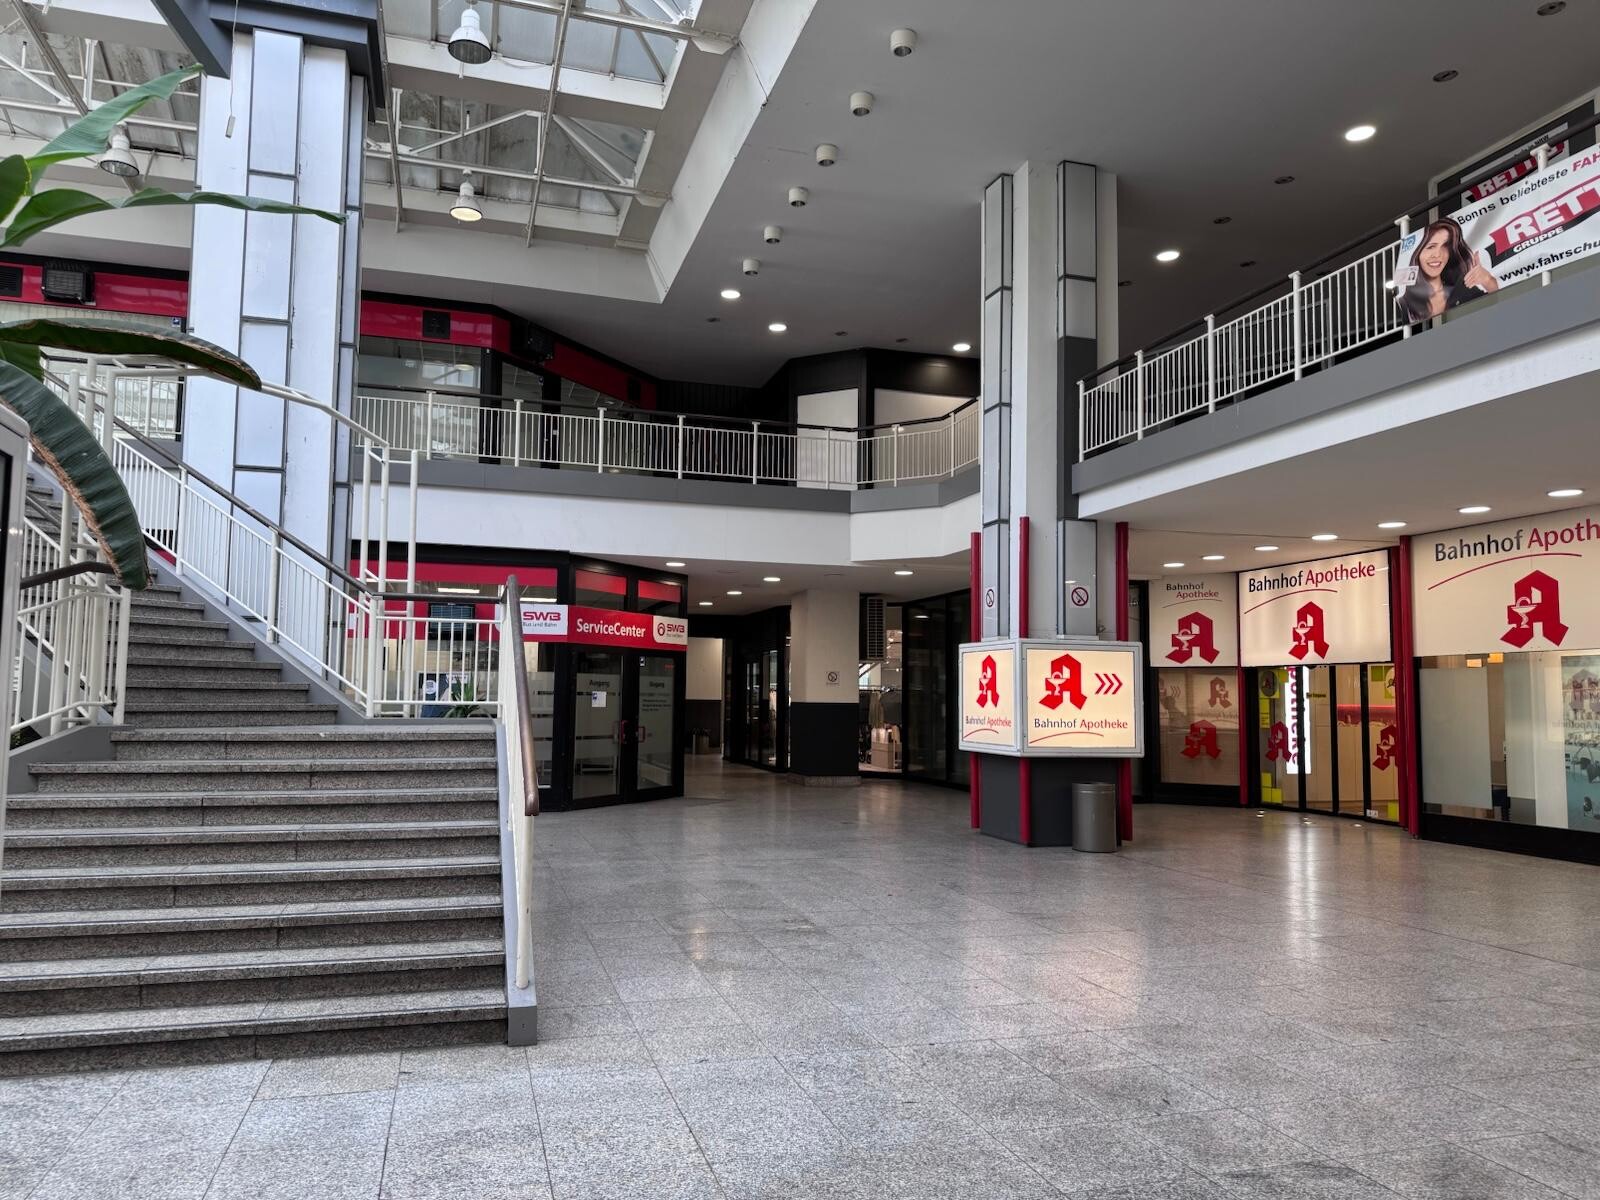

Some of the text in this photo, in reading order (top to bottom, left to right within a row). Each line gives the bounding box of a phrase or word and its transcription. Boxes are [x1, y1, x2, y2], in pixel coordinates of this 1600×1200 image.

[1457, 201, 1497, 226] Bonns
[1499, 167, 1569, 206] beliebteste
[1513, 225, 1564, 253] GRUPPE
[1434, 517, 1600, 562] Bahnhof Apoth
[1248, 561, 1376, 593] Bahnhof Apotheke
[1166, 582, 1205, 591] Bahnhof
[1176, 589, 1219, 600] Apotheke
[523, 611, 562, 621] SWB
[576, 618, 647, 638] ServiceCenter
[666, 623, 685, 633] SWB
[965, 715, 1012, 729] Bahnhof Apotheke
[1034, 717, 1129, 731] Bahnhof Apotheke
